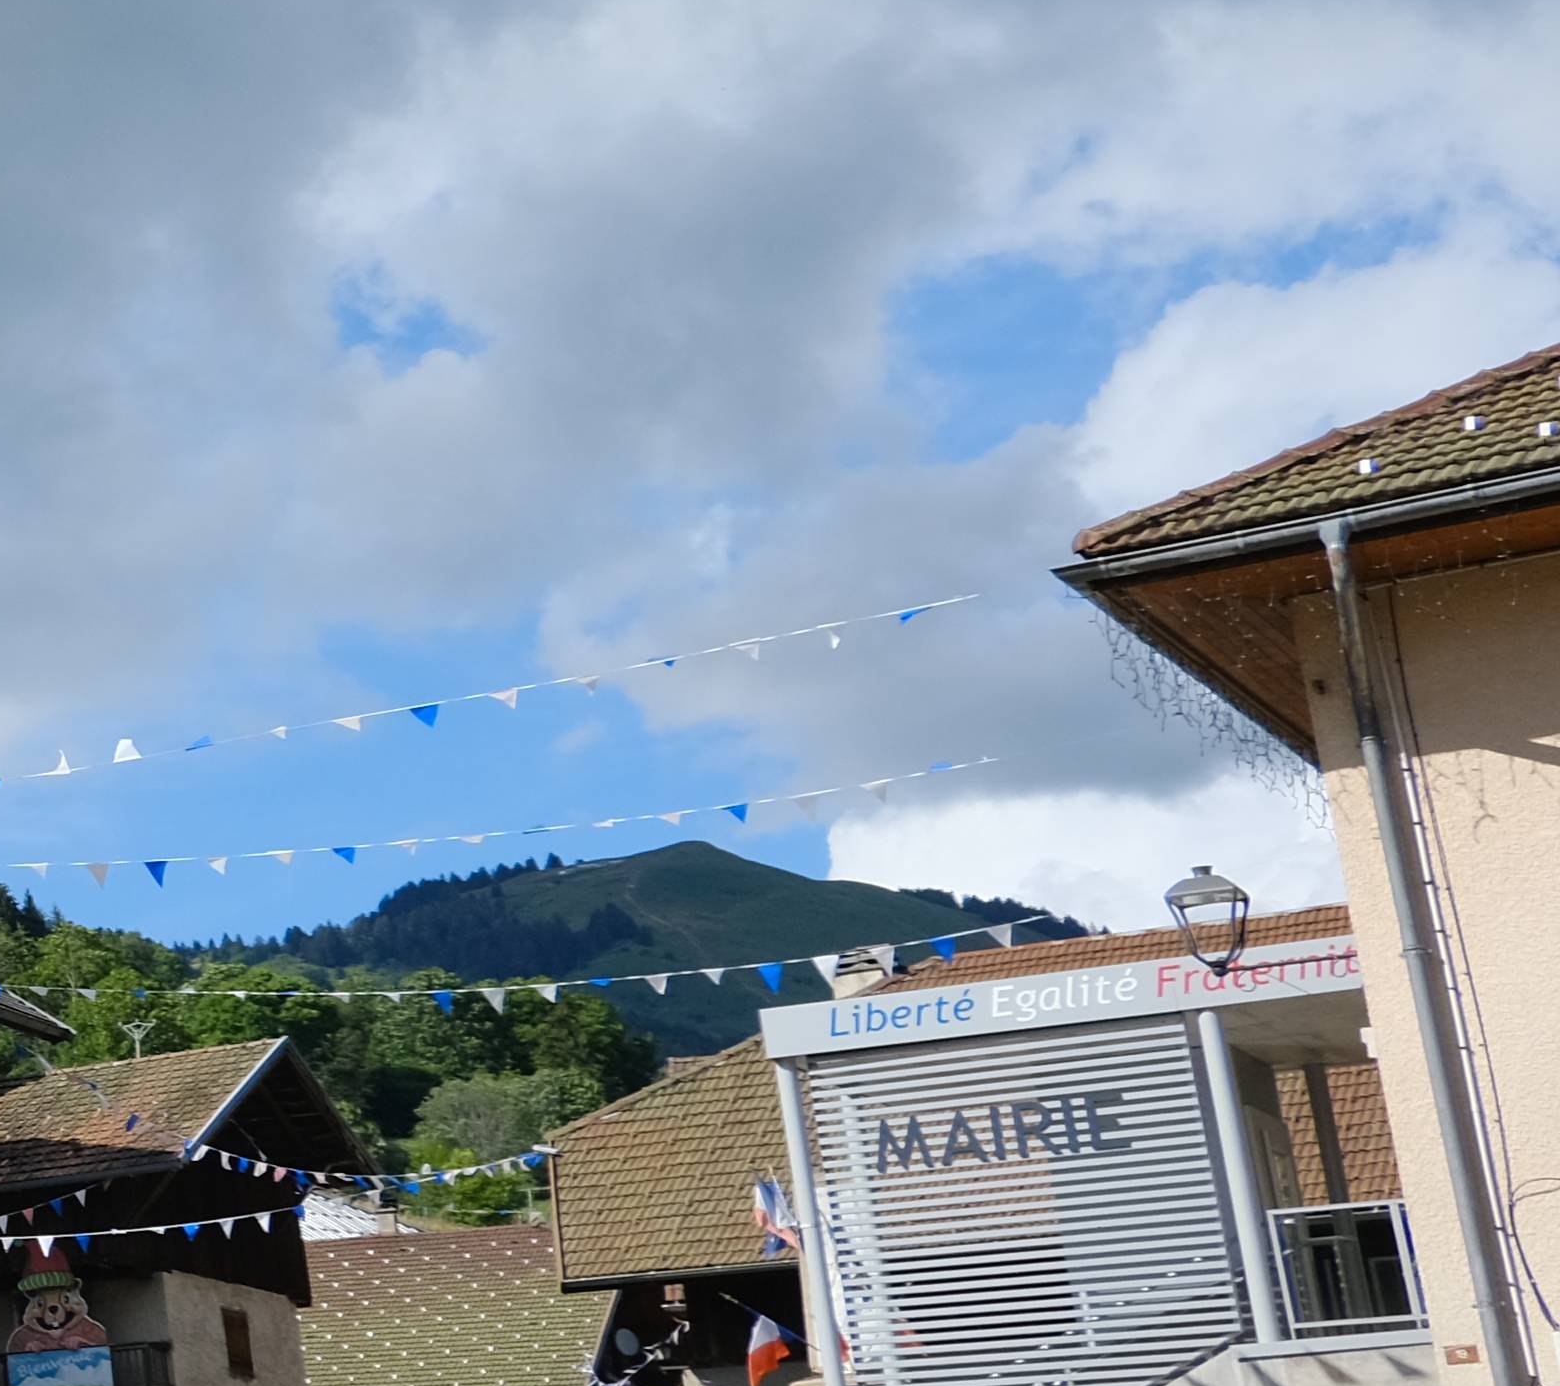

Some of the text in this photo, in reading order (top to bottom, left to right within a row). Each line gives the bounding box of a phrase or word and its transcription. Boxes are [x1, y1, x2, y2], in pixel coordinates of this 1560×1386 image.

[829, 988, 976, 1038] Liberté
[990, 967, 1138, 1023] Egalité
[876, 1090, 1132, 1174] MAIRIE
